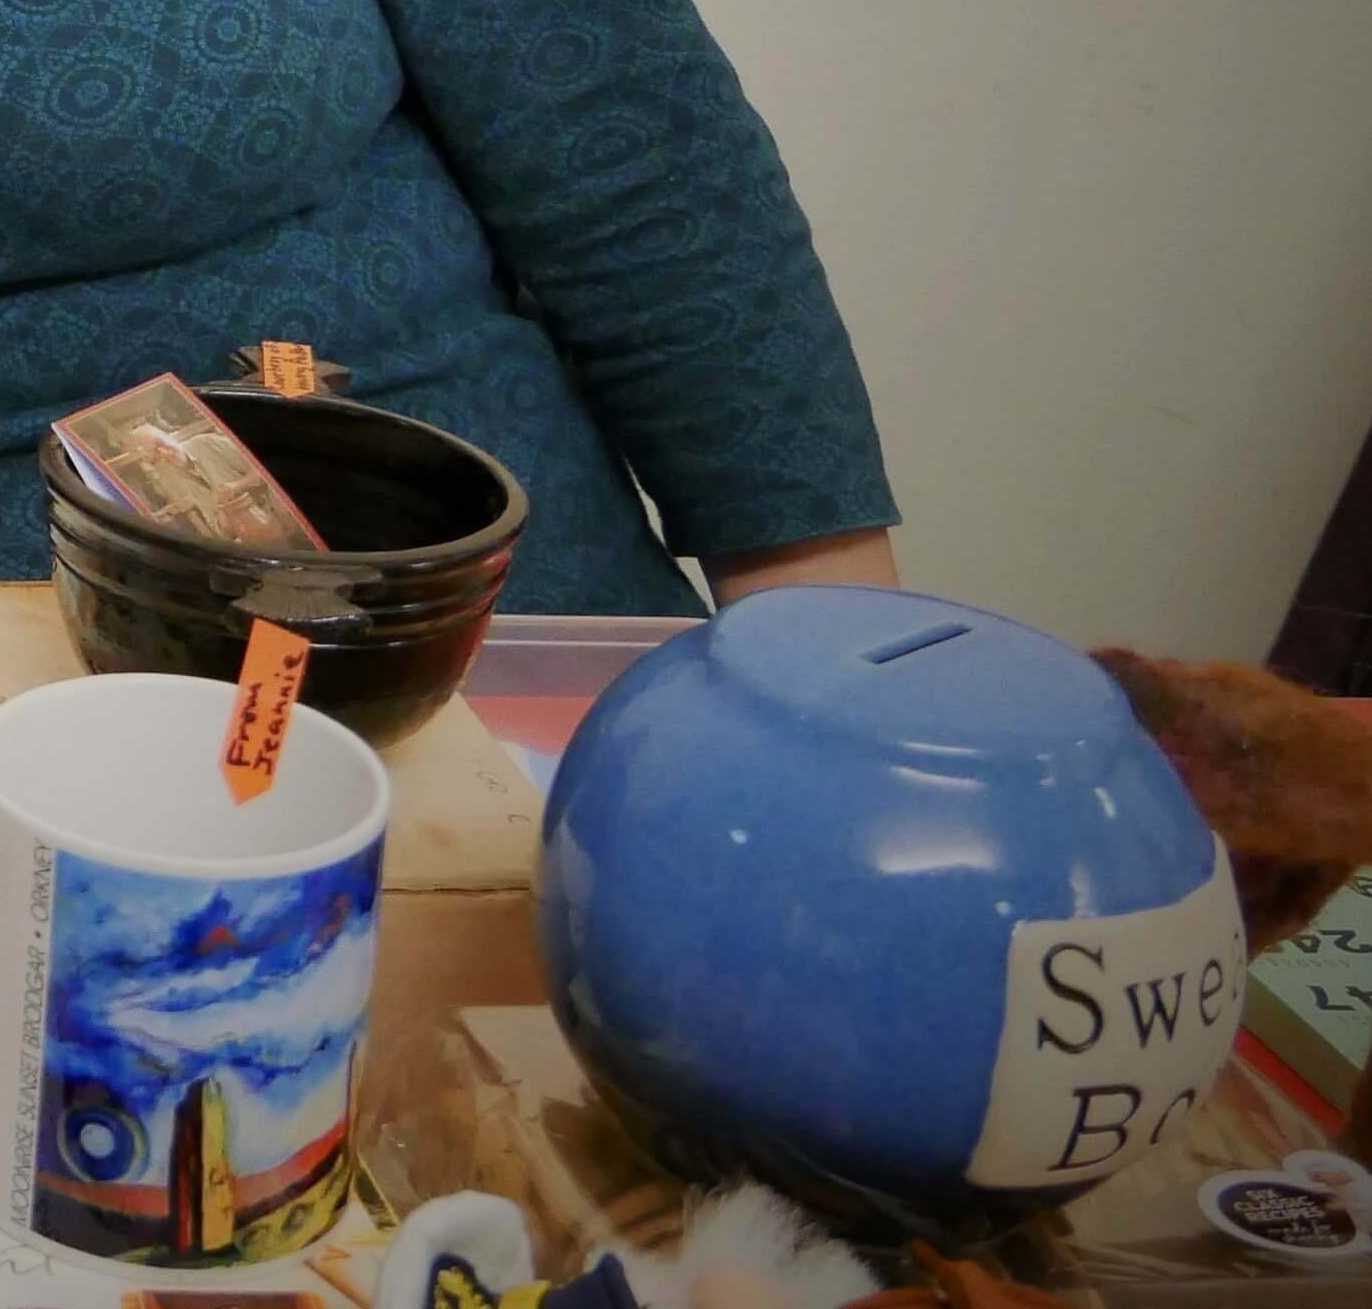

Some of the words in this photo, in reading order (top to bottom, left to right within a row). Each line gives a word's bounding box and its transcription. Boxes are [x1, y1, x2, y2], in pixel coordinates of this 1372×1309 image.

[225, 681, 263, 768] From
[253, 650, 305, 776] Jeannie
[1036, 931, 1243, 1055] Swe
